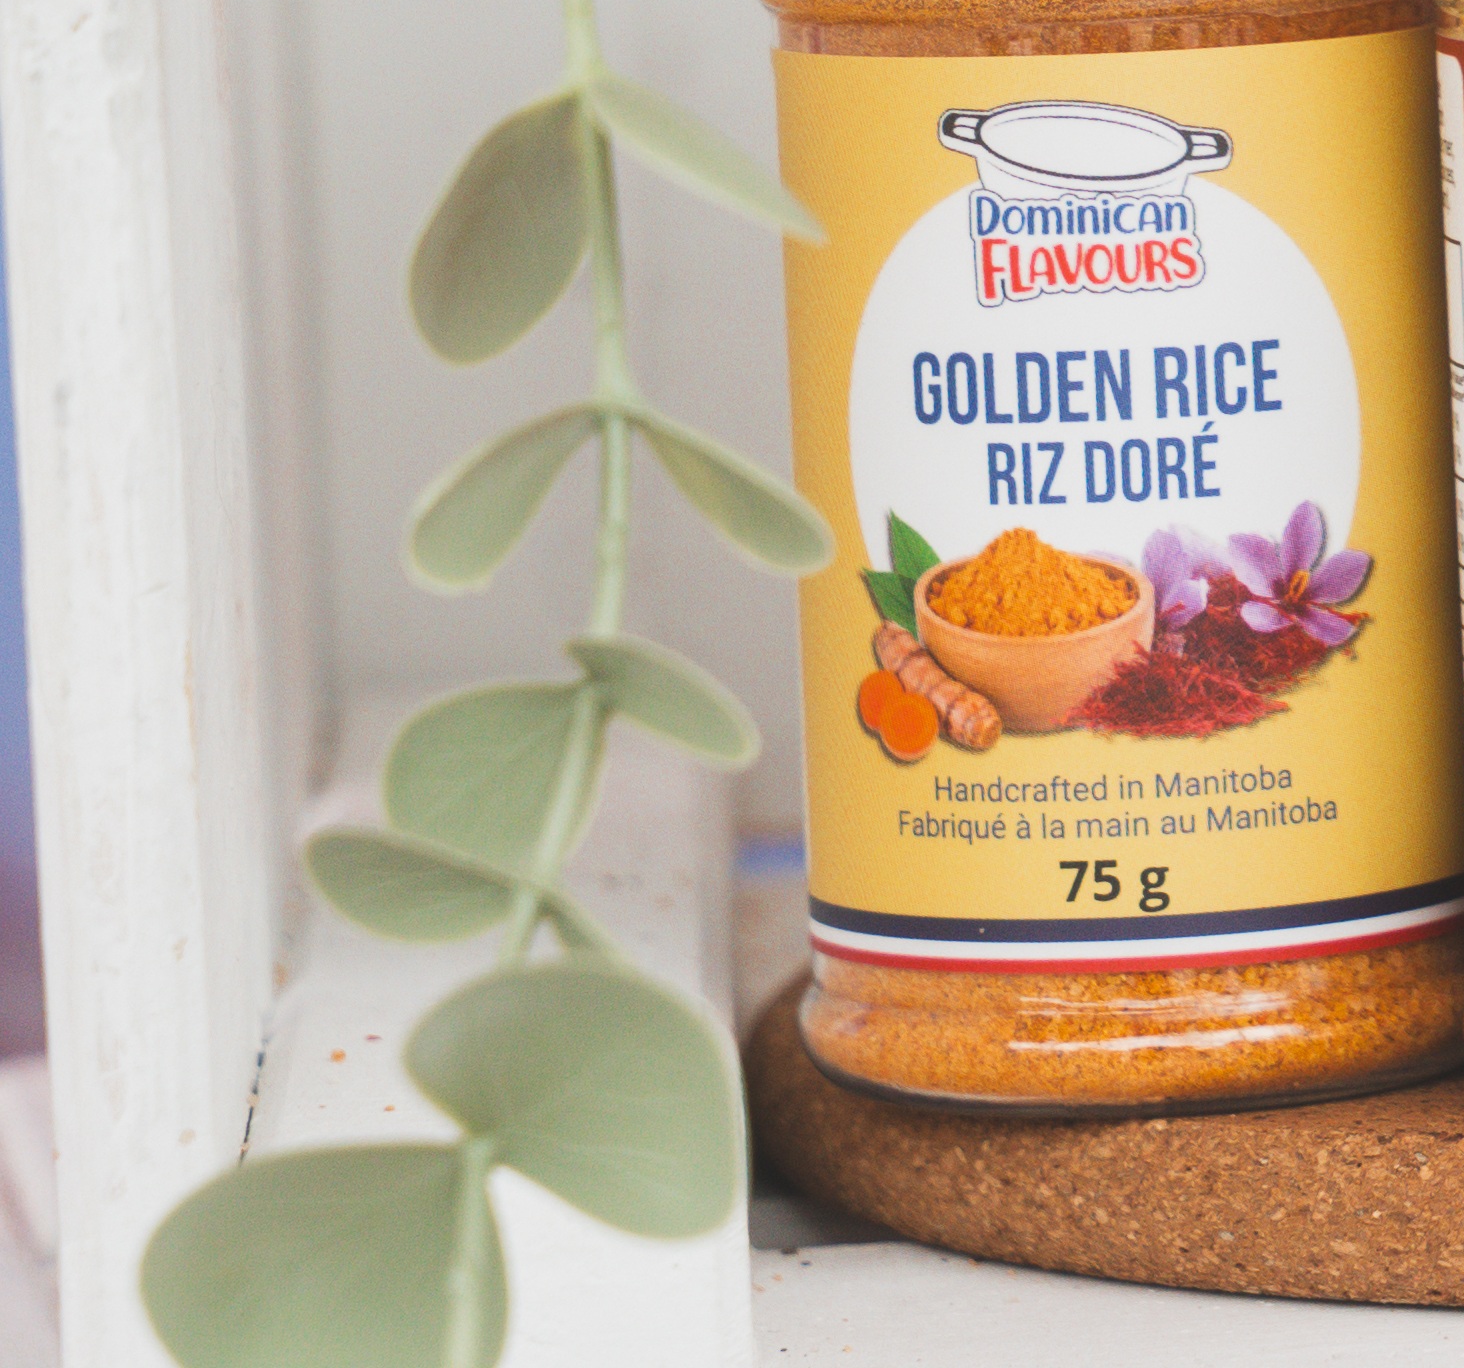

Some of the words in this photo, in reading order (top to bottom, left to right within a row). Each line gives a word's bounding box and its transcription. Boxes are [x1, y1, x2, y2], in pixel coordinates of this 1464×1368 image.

[981, 237, 1197, 299] FLAVOURS
[914, 348, 1132, 424] GOLDEN
[1155, 339, 1282, 417] RICE
[987, 441, 1066, 505] RIZ
[1084, 421, 1220, 503] DORÉ
[934, 773, 1108, 802] Handcrafted
[1119, 773, 1144, 799] in
[1155, 765, 1292, 798] Manitoba
[899, 810, 1006, 844] Fabriqué
[1017, 813, 1032, 839] à
[1041, 813, 1066, 839] la
[1076, 814, 1149, 838] main
[1160, 812, 1196, 835] au
[1207, 798, 1338, 832] Manitoba
[1059, 860, 1121, 902] 75
[1139, 866, 1170, 912] g
